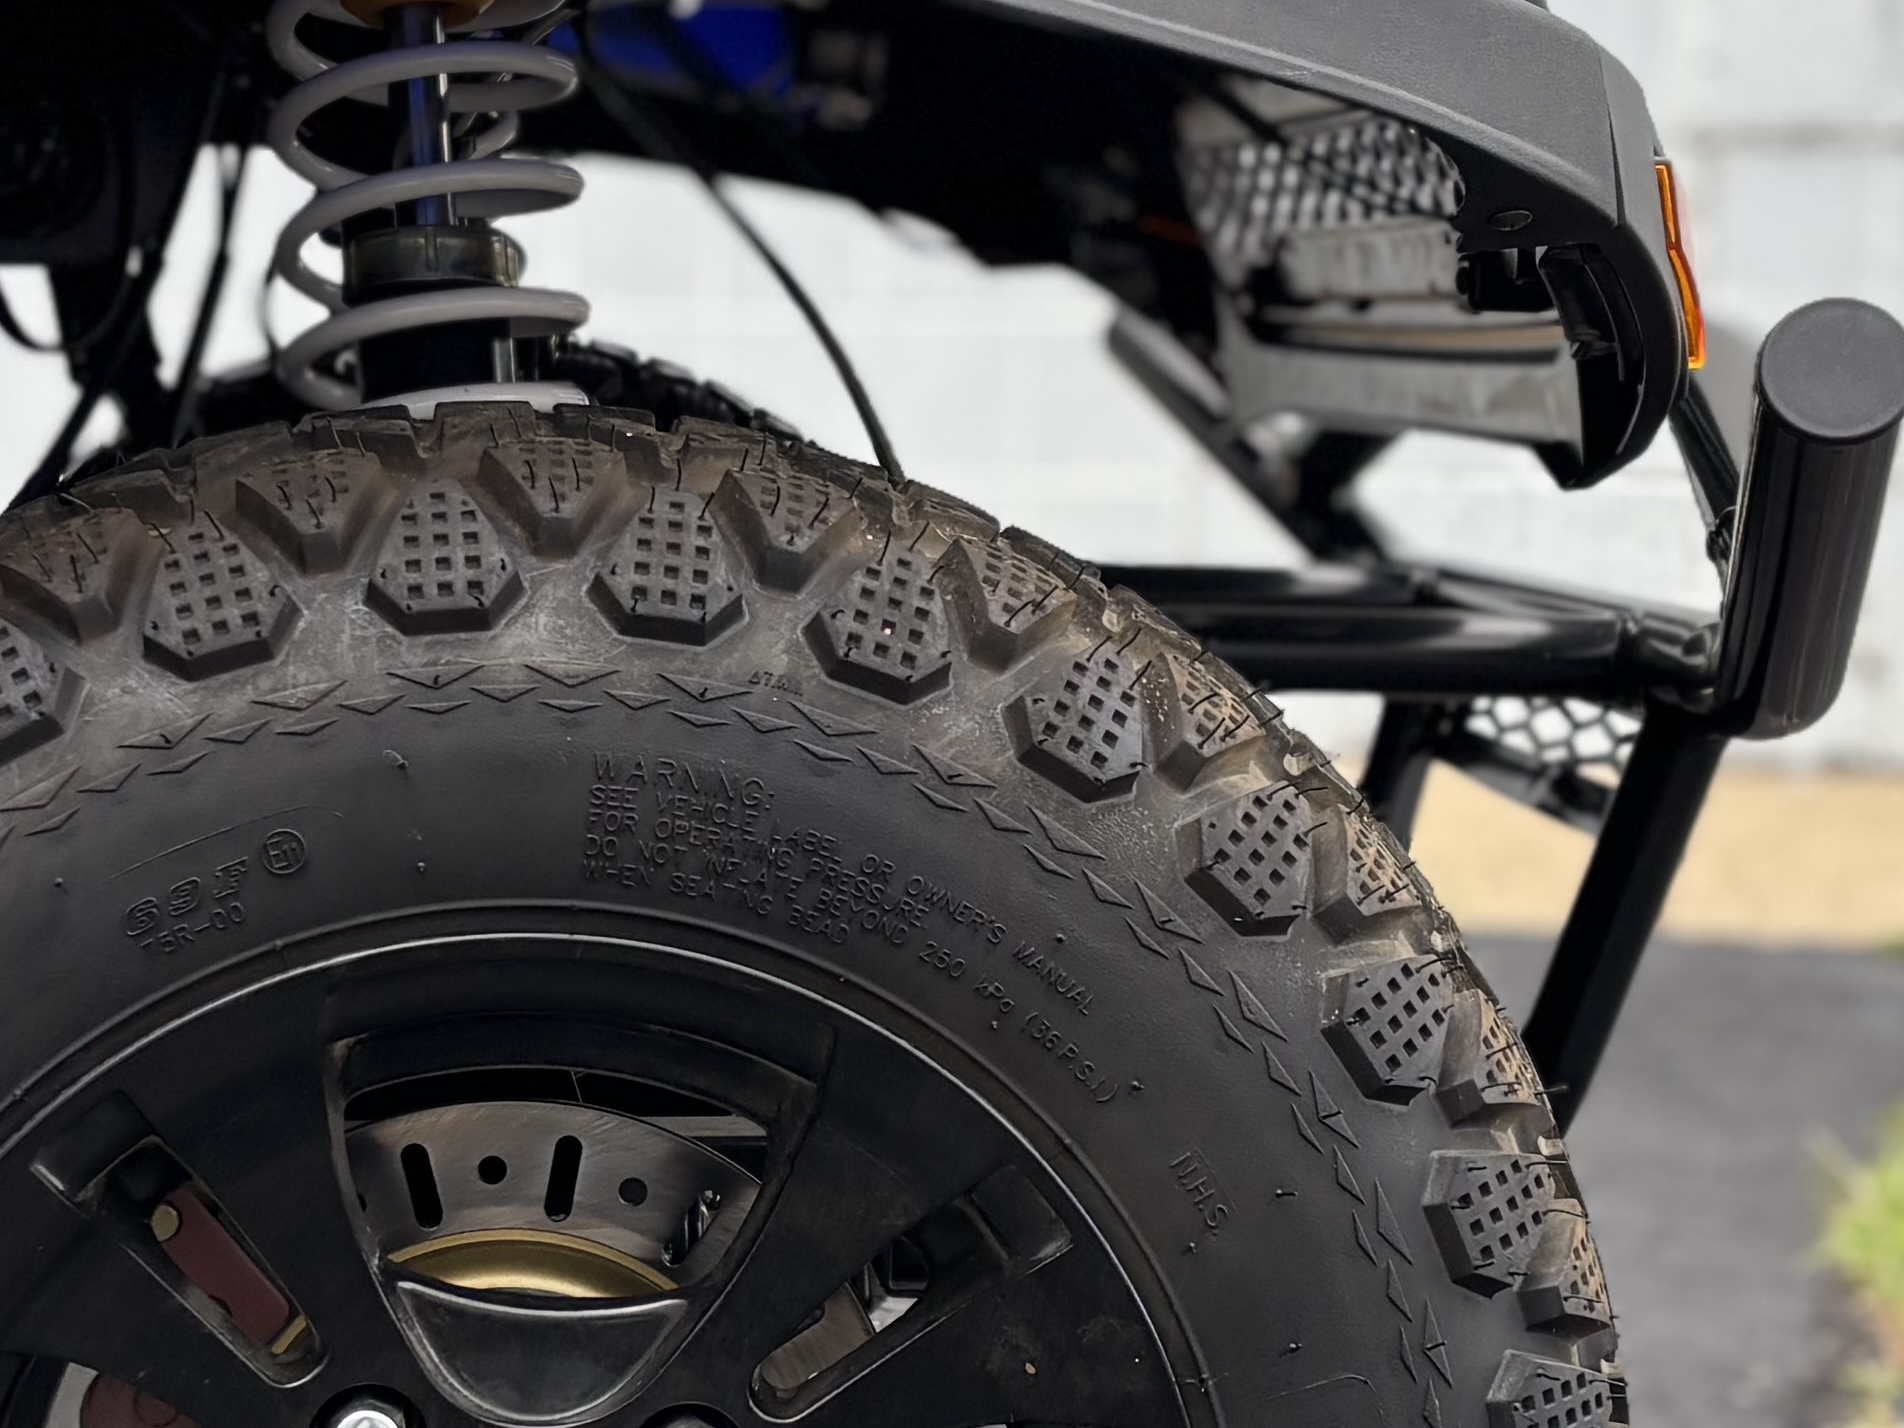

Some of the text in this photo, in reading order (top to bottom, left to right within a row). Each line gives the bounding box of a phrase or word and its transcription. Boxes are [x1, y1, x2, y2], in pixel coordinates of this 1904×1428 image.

[589, 783, 640, 808] SEE
[862, 853, 895, 882] OR
[1011, 939, 1094, 1016] MANUAL
[918, 939, 966, 977] 250
